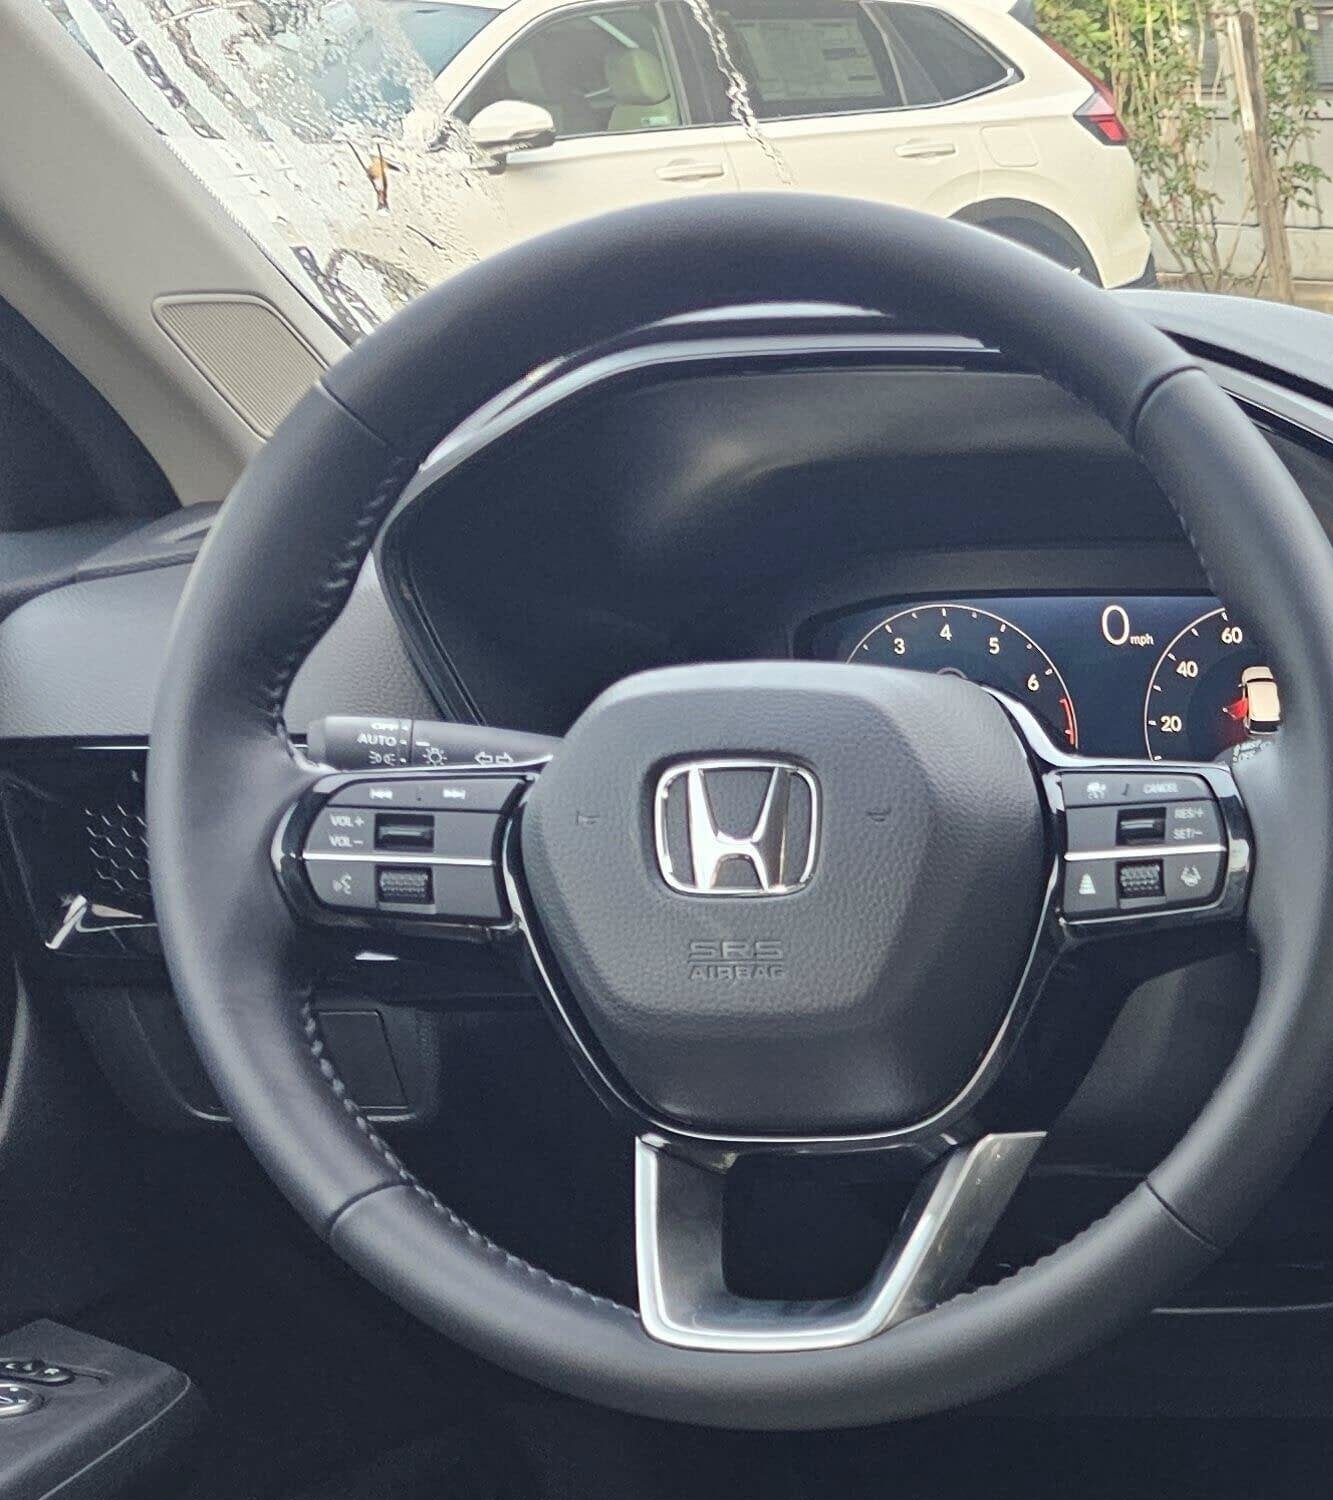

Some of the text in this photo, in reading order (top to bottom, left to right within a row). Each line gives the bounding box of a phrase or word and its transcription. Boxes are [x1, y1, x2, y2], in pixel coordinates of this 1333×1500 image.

[939, 624, 953, 641] 4
[1101, 604, 1155, 647] 0 mph
[1221, 627, 1244, 645] 60
[893, 637, 907, 655] 3
[988, 637, 1001, 655] 5
[1175, 660, 1199, 679] 40
[1027, 674, 1040, 691] 6
[1160, 714, 1183, 733] 20
[357, 733, 397, 746] AUTO
